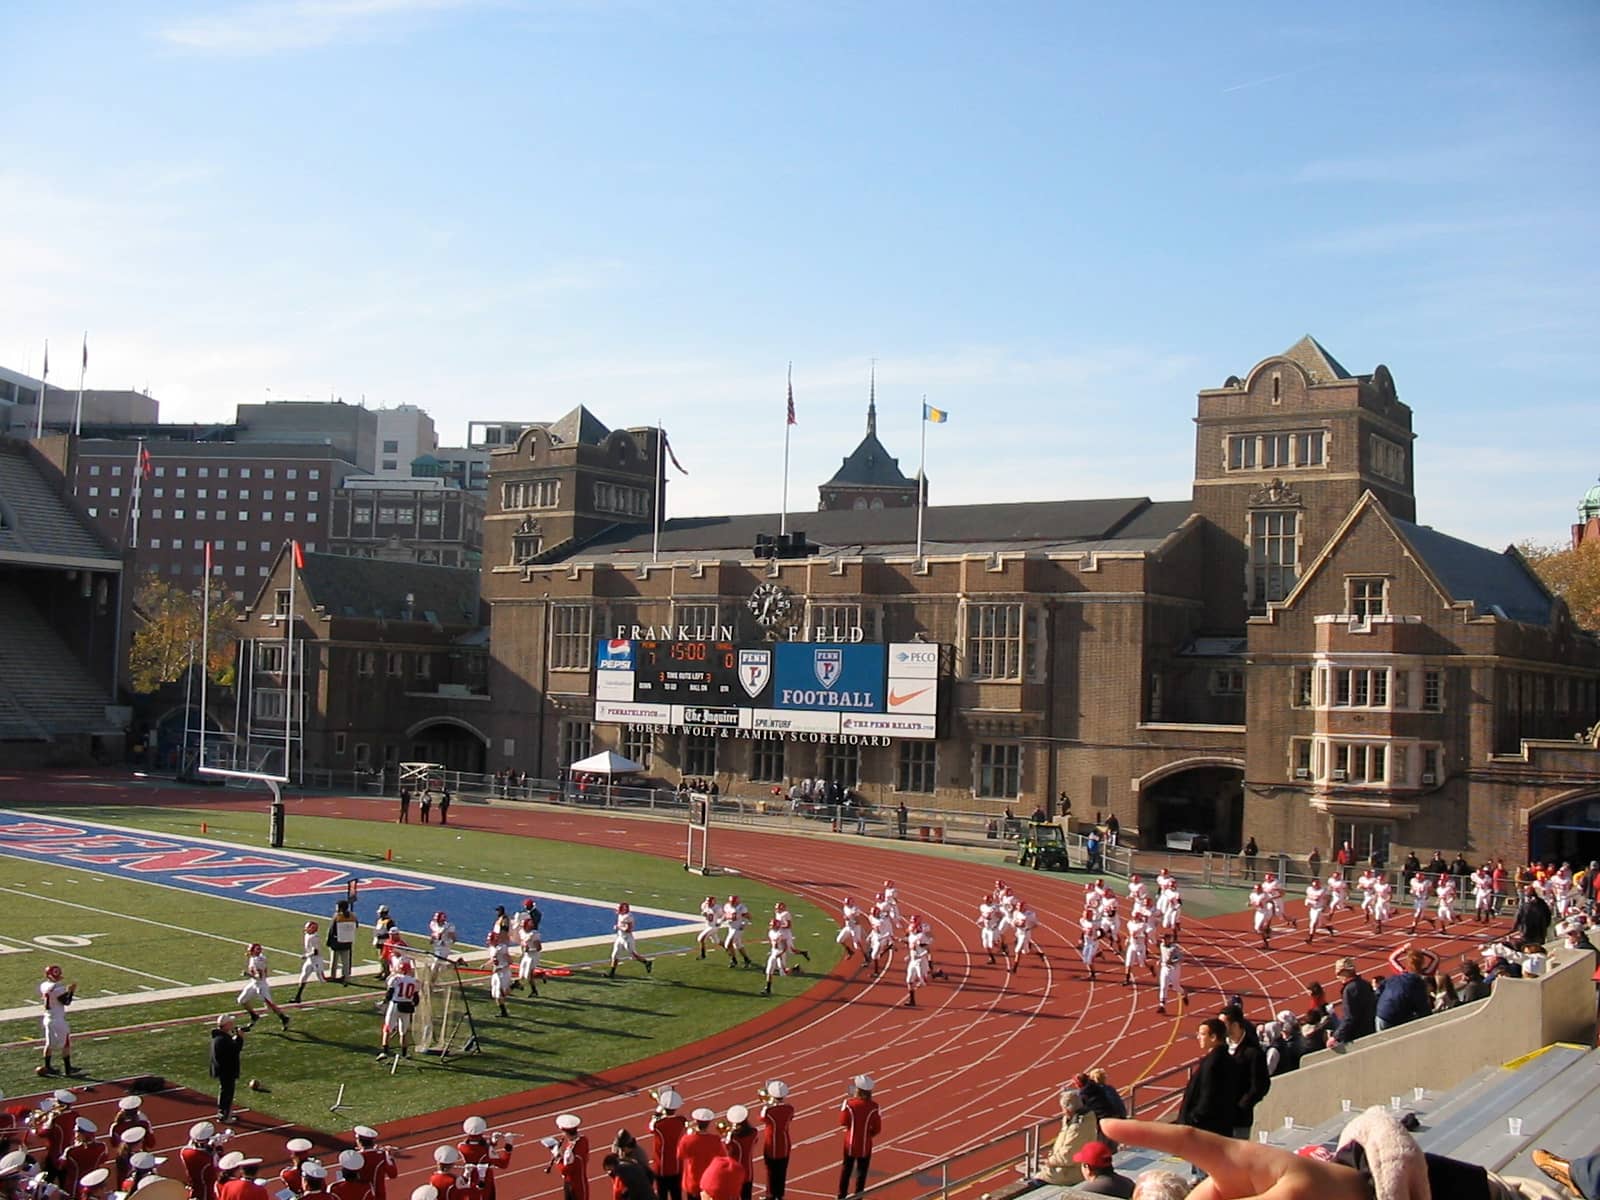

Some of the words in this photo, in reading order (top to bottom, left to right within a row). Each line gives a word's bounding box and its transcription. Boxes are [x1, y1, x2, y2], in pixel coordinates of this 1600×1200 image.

[617, 625, 733, 641] FRANKLIN
[788, 626, 864, 643] FIELD
[671, 643, 705, 660] 15:00
[742, 653, 768, 663] PENN
[817, 652, 839, 660] PENN
[911, 652, 936, 662] PECO
[600, 660, 632, 669] PEPSI
[725, 653, 734, 669] 0
[749, 667, 761, 686] P
[782, 689, 874, 708] FOOTBALL
[685, 709, 701, 723] The
[703, 709, 738, 725] Inquirer
[628, 724, 678, 735] ROBERT
[682, 726, 717, 738] WOLF
[720, 729, 729, 738] &
[735, 728, 786, 742] FAMILY
[791, 731, 892, 747] SCOREBOARD
[397, 982, 416, 1000] 10
